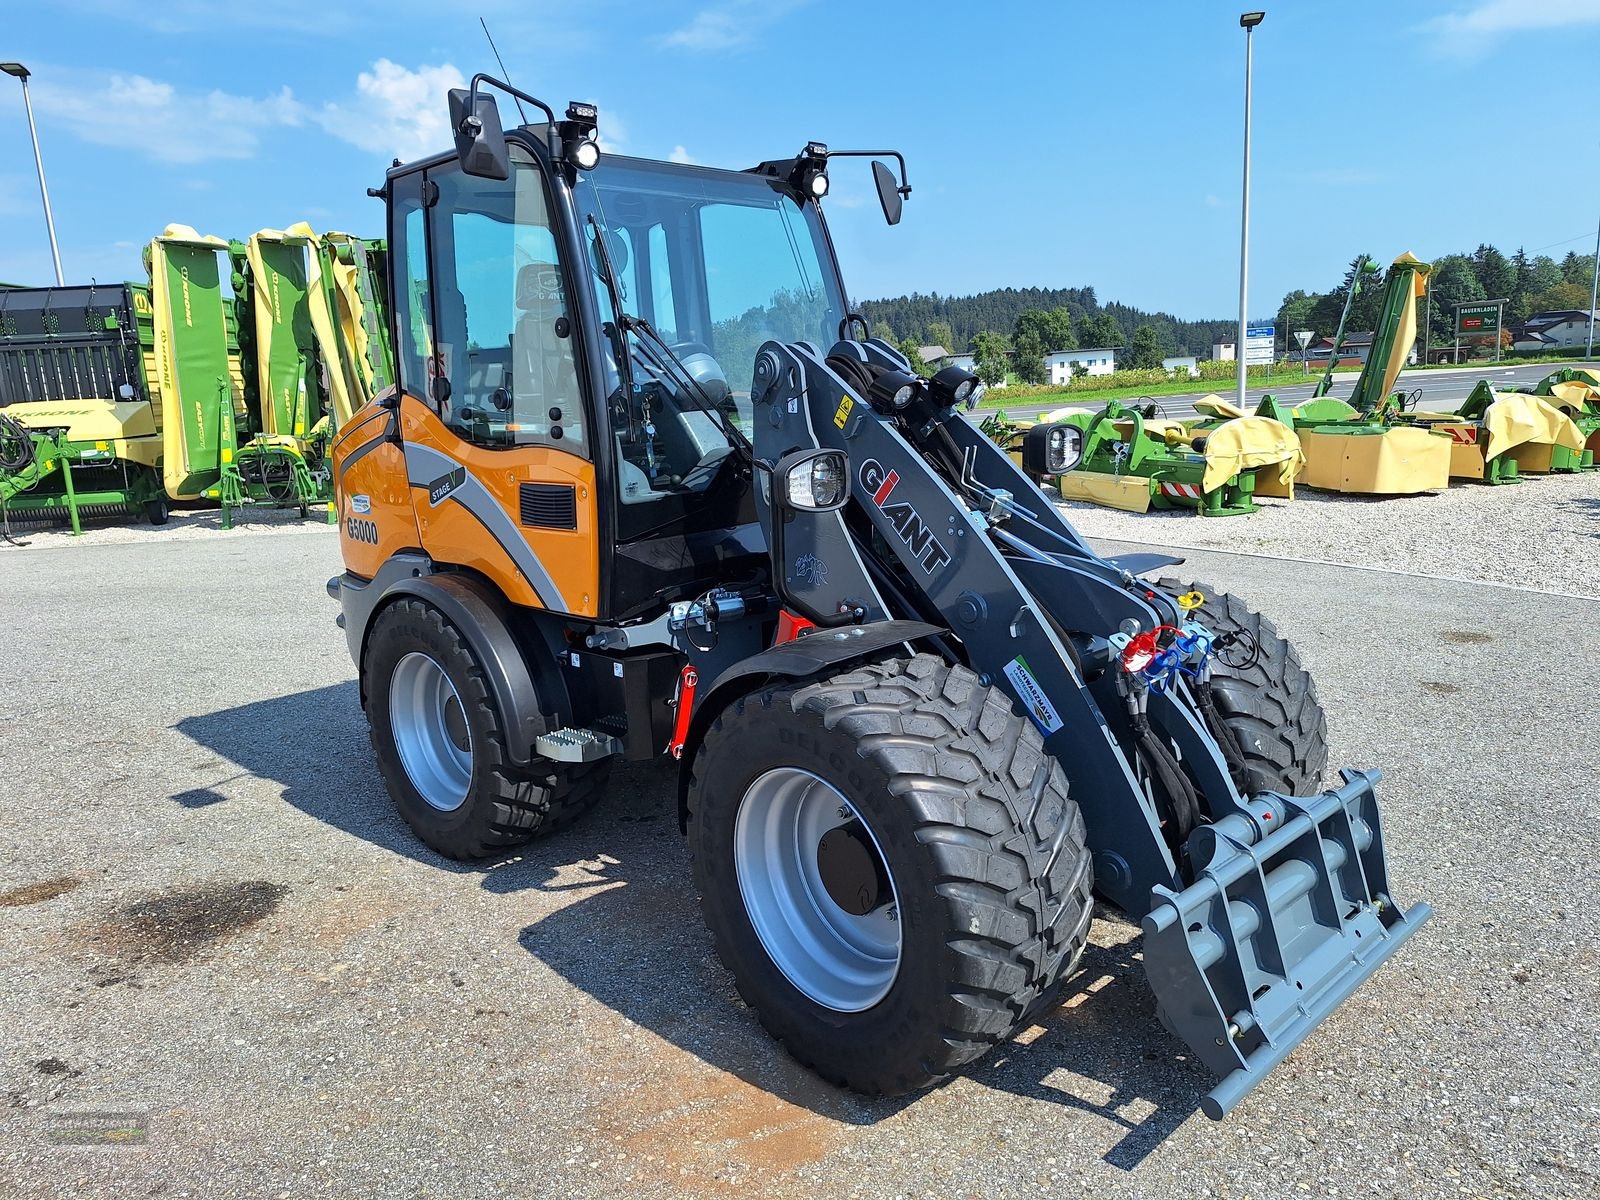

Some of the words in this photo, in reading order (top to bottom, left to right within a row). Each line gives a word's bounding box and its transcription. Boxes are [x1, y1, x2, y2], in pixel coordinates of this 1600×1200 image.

[182, 280, 193, 327] KRONE
[273, 284, 282, 325] KRONE
[538, 292, 565, 300] GANT
[1461, 306, 1497, 314] BAUERNLADEN
[431, 482, 451, 500] STAGE
[347, 516, 379, 545] G5000
[859, 458, 952, 575] GIANT
[1016, 665, 1052, 720] SCHWARZMAYR
